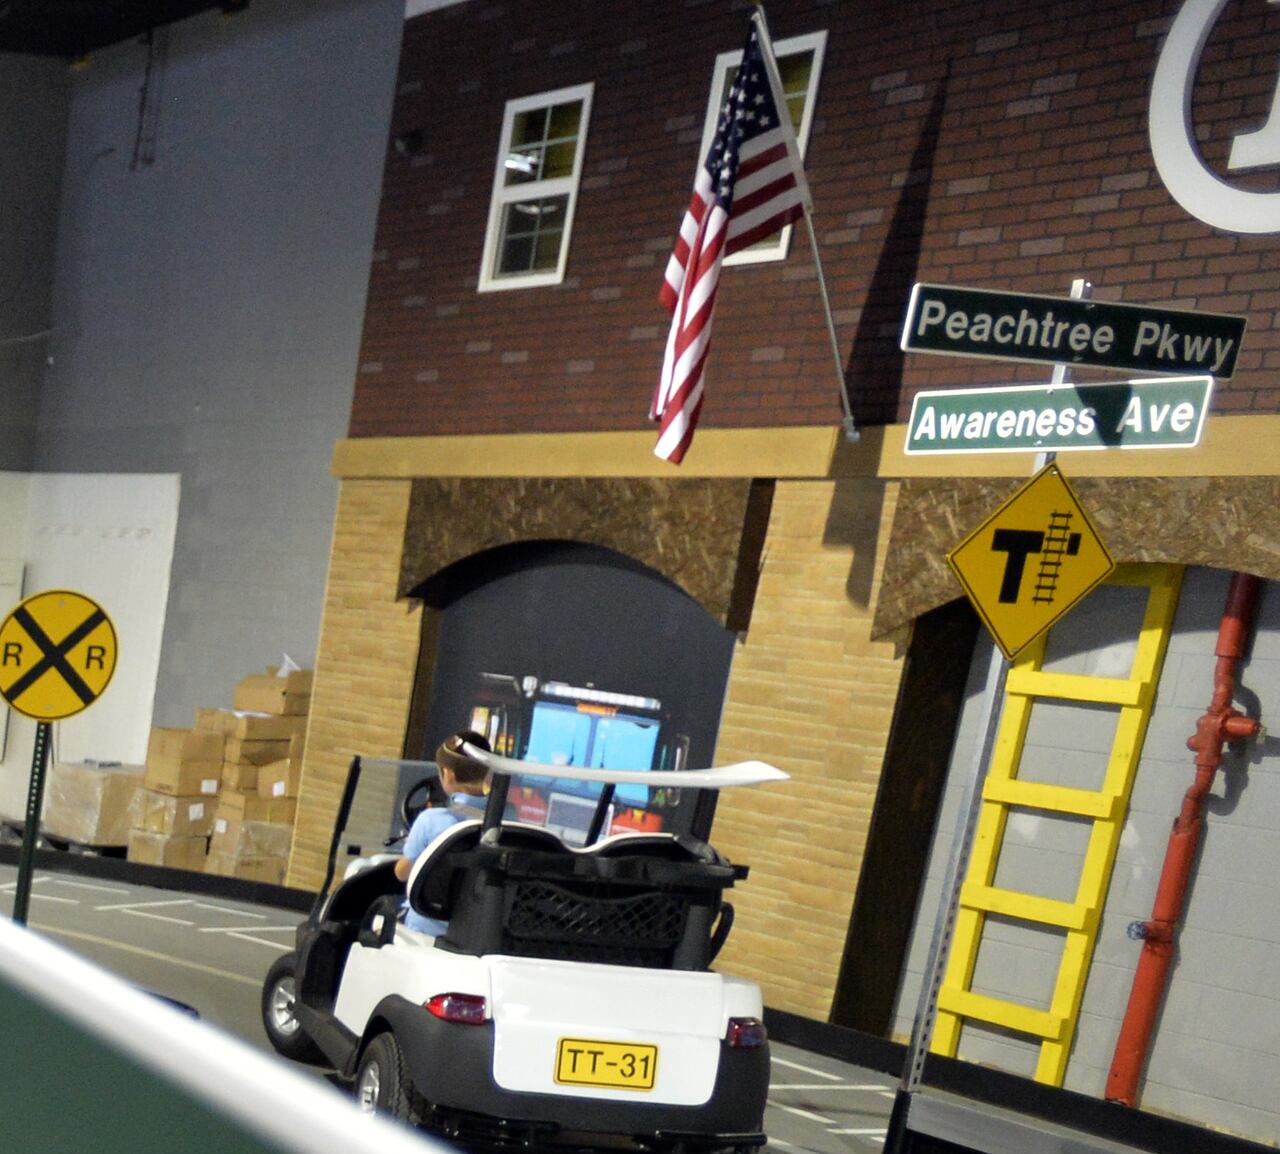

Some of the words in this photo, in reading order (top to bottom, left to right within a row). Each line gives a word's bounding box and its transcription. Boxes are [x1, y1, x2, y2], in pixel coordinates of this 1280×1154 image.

[917, 299, 1115, 354] Peachtree
[1133, 321, 1233, 373] Pkwy
[913, 405, 1096, 441] Awareness
[1115, 396, 1194, 433] Ave
[2, 641, 23, 667] R
[85, 645, 107, 670] R
[567, 1048, 649, 1079] TT-31
